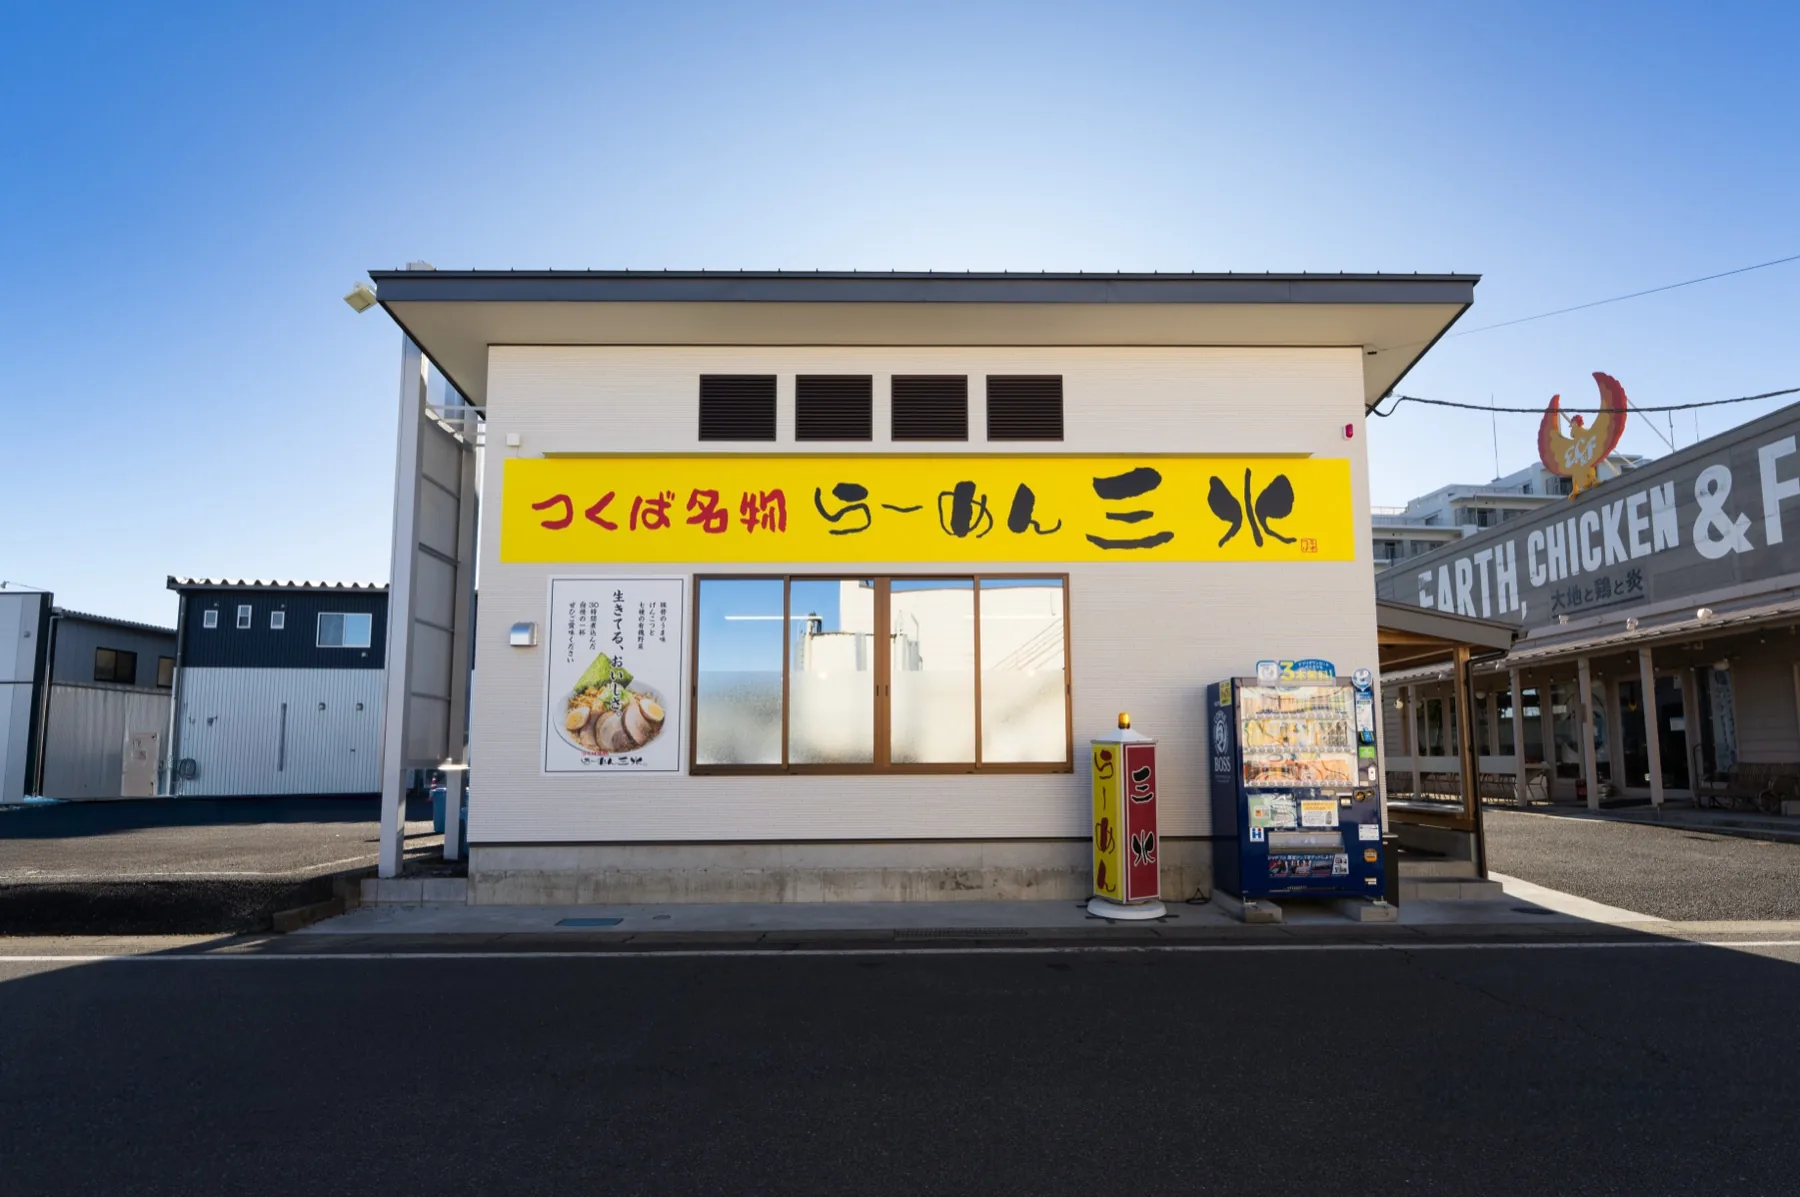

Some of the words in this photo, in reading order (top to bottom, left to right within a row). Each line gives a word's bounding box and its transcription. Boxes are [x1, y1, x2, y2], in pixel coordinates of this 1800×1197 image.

[531, 488, 787, 534] つくば名物
[1528, 481, 1680, 588] CHICKEN
[1692, 464, 1754, 560] &
[1550, 568, 1643, 612] 大地と鶏と炎
[610, 589, 625, 717] 生きてる、おいしさ。
[1214, 756, 1231, 772] BOSS
